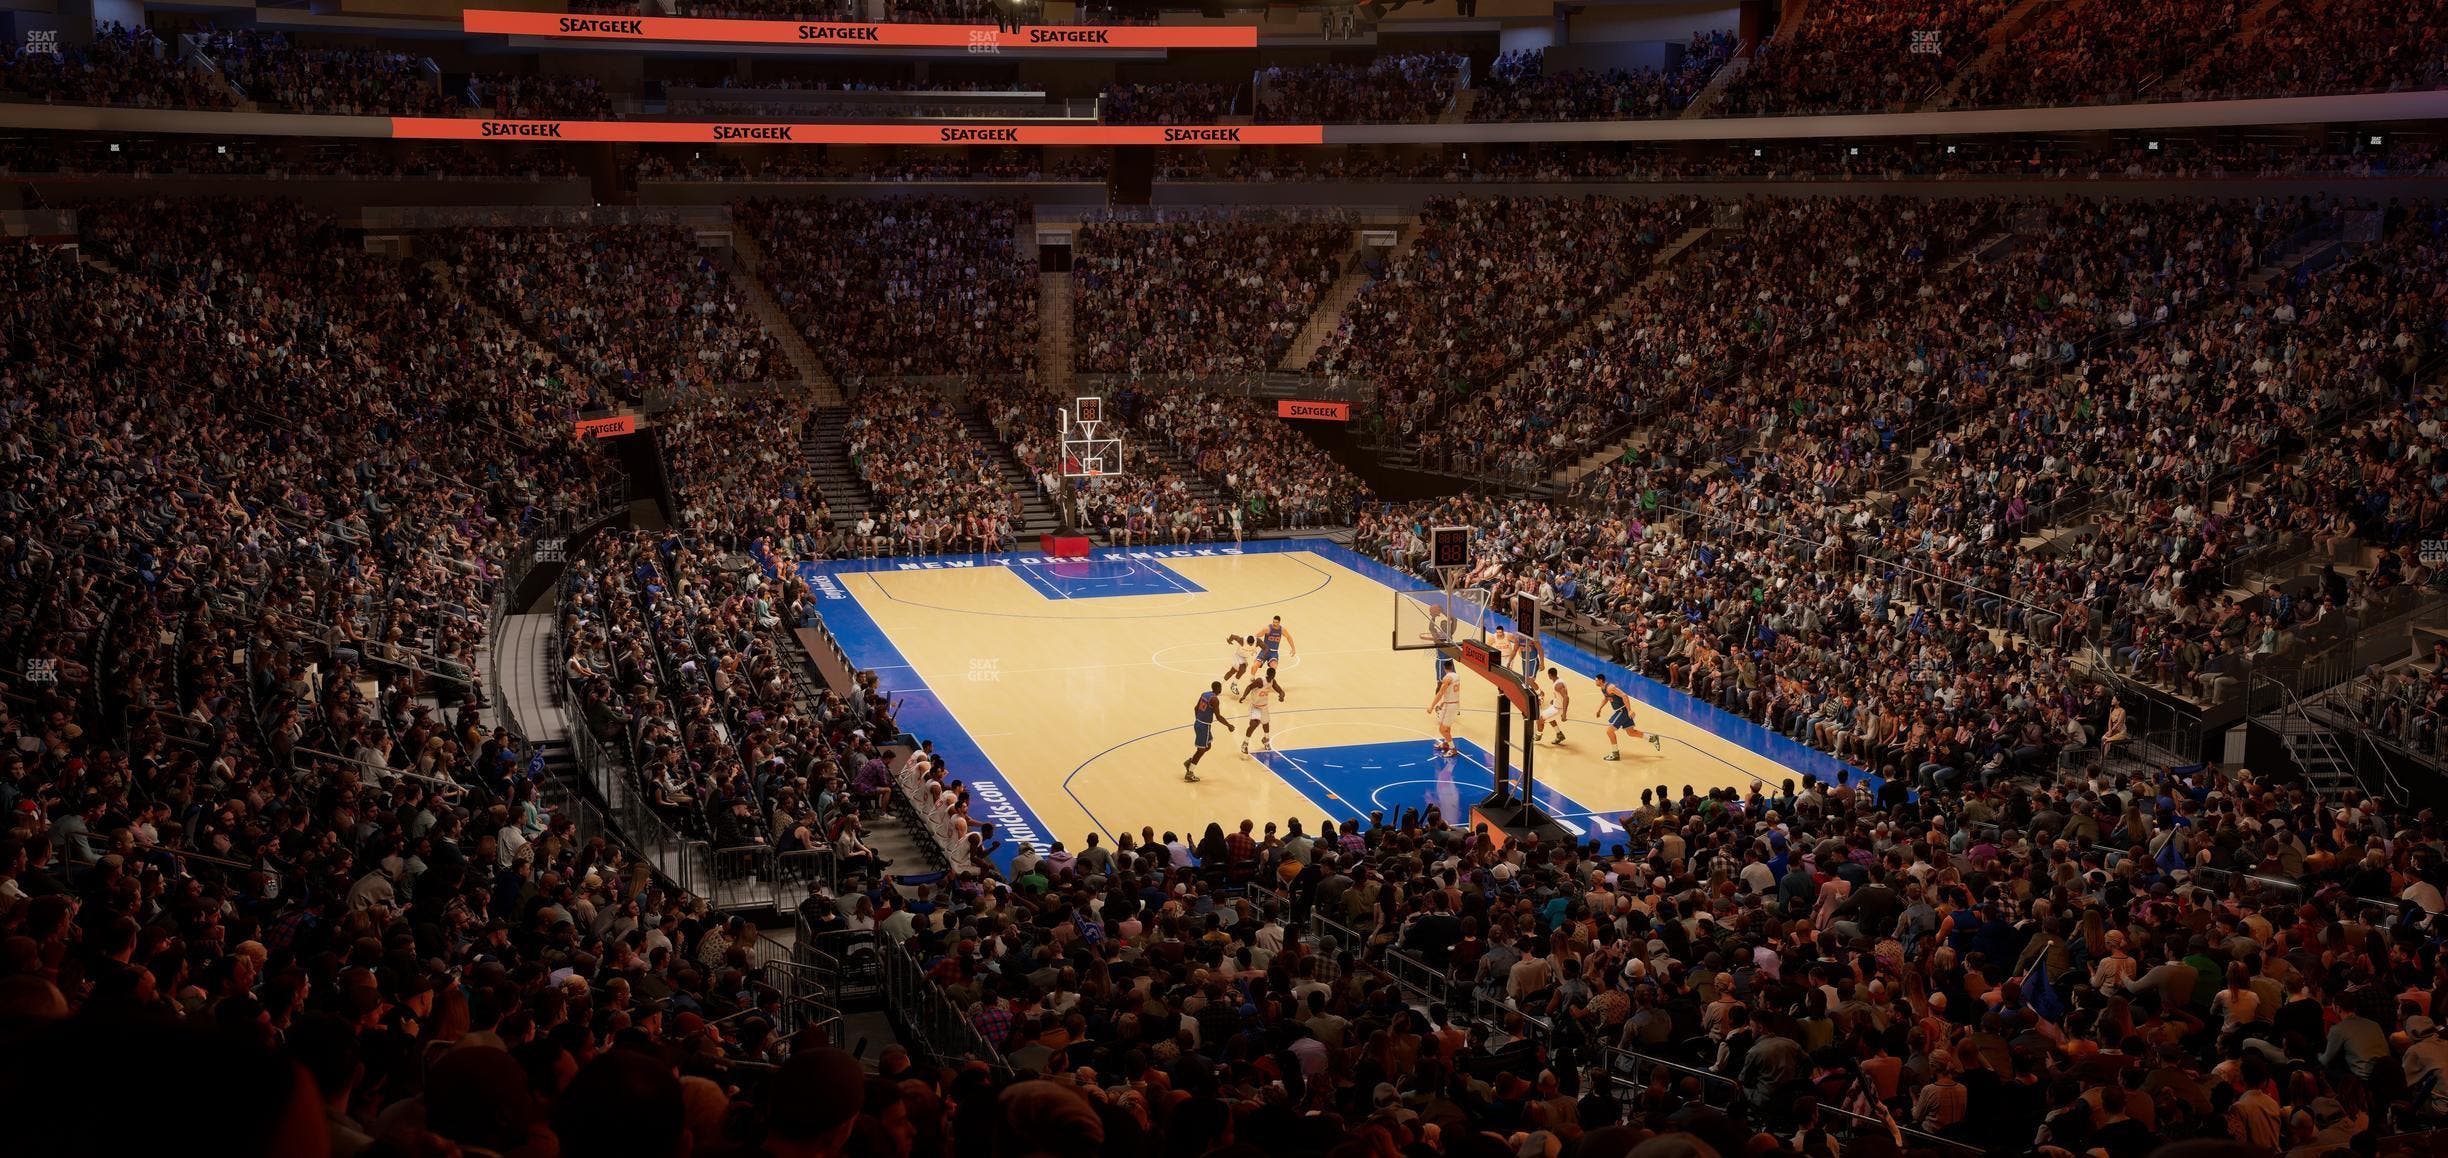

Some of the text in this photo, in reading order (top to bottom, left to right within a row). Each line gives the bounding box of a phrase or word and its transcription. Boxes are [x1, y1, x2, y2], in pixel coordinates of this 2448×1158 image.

[560, 18, 642, 34] SEATGEEK
[799, 25, 878, 40] SEATGEEK
[1031, 29, 1108, 43] SEATGEEK
[482, 121, 561, 137] SEATGEEK
[714, 126, 792, 140] SEATGEEK
[941, 128, 1017, 141] SEATGEEK
[1165, 128, 1240, 141] SEATGEEK
[1291, 406, 1337, 418] SEATGEEK
[897, 560, 974, 570] NEW
[1103, 548, 1244, 560] KNICKS
